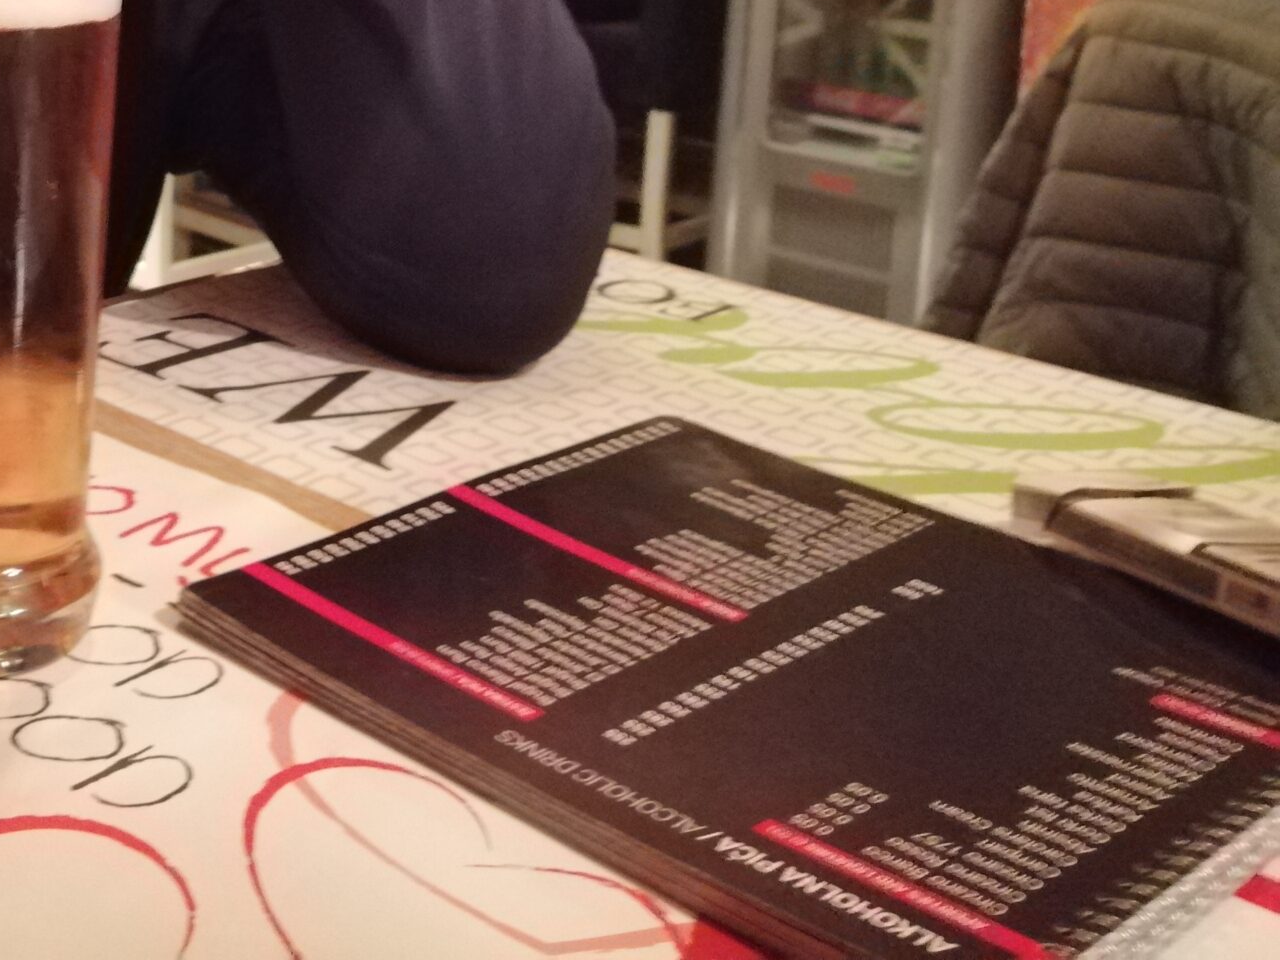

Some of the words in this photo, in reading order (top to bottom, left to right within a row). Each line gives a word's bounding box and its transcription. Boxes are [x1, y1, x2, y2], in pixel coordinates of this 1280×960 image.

[492, 728, 582, 775] DRINKS
[571, 767, 709, 834] ALCOHOLIC
[779, 865, 960, 954] ALKOHOLNA
